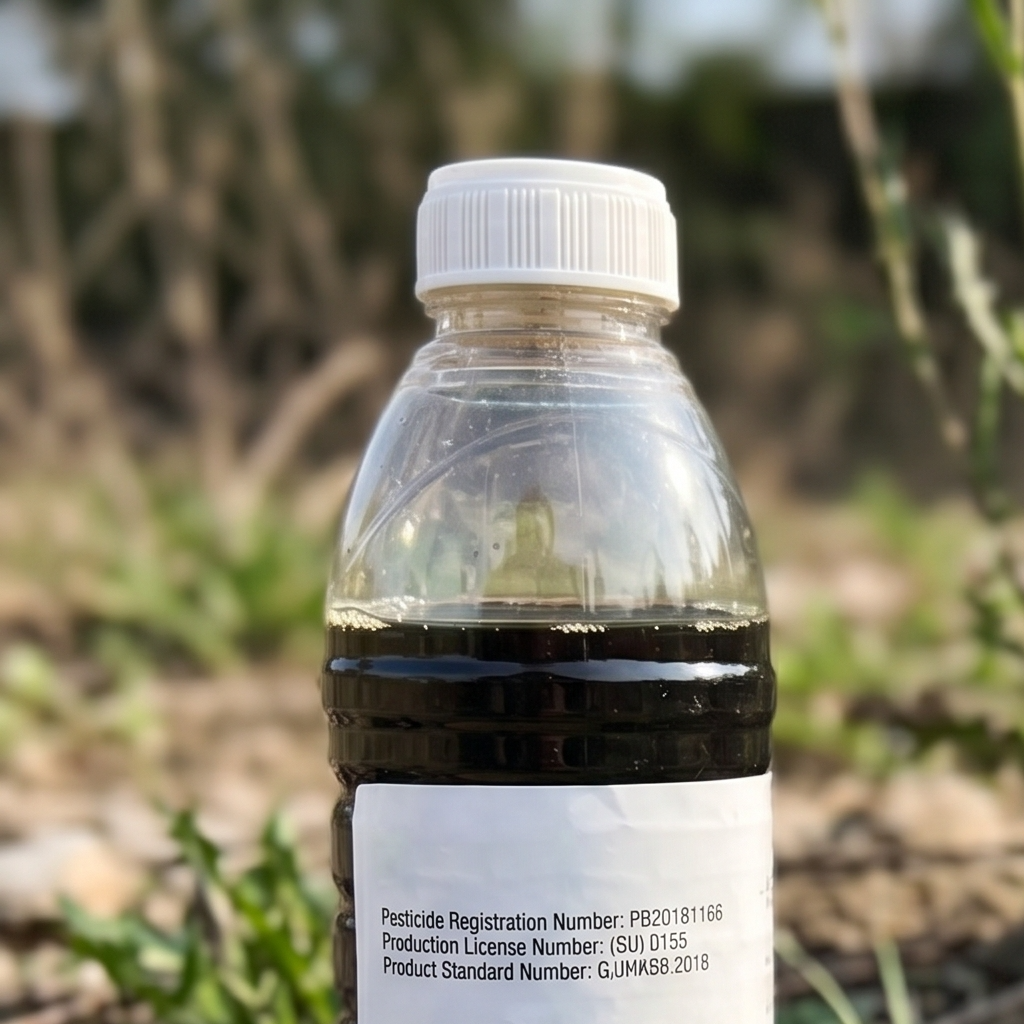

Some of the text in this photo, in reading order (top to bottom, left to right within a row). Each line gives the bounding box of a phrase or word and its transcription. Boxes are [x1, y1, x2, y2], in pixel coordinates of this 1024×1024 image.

[381, 903, 724, 935] Pesticide Registration Number: PB20181166
[382, 932, 459, 955] Production
[464, 937, 527, 956] License
[532, 938, 604, 956] Number:
[610, 934, 645, 957] (SU)
[383, 956, 438, 979] Product
[441, 960, 514, 980] Standard
[520, 962, 592, 981] Number:
